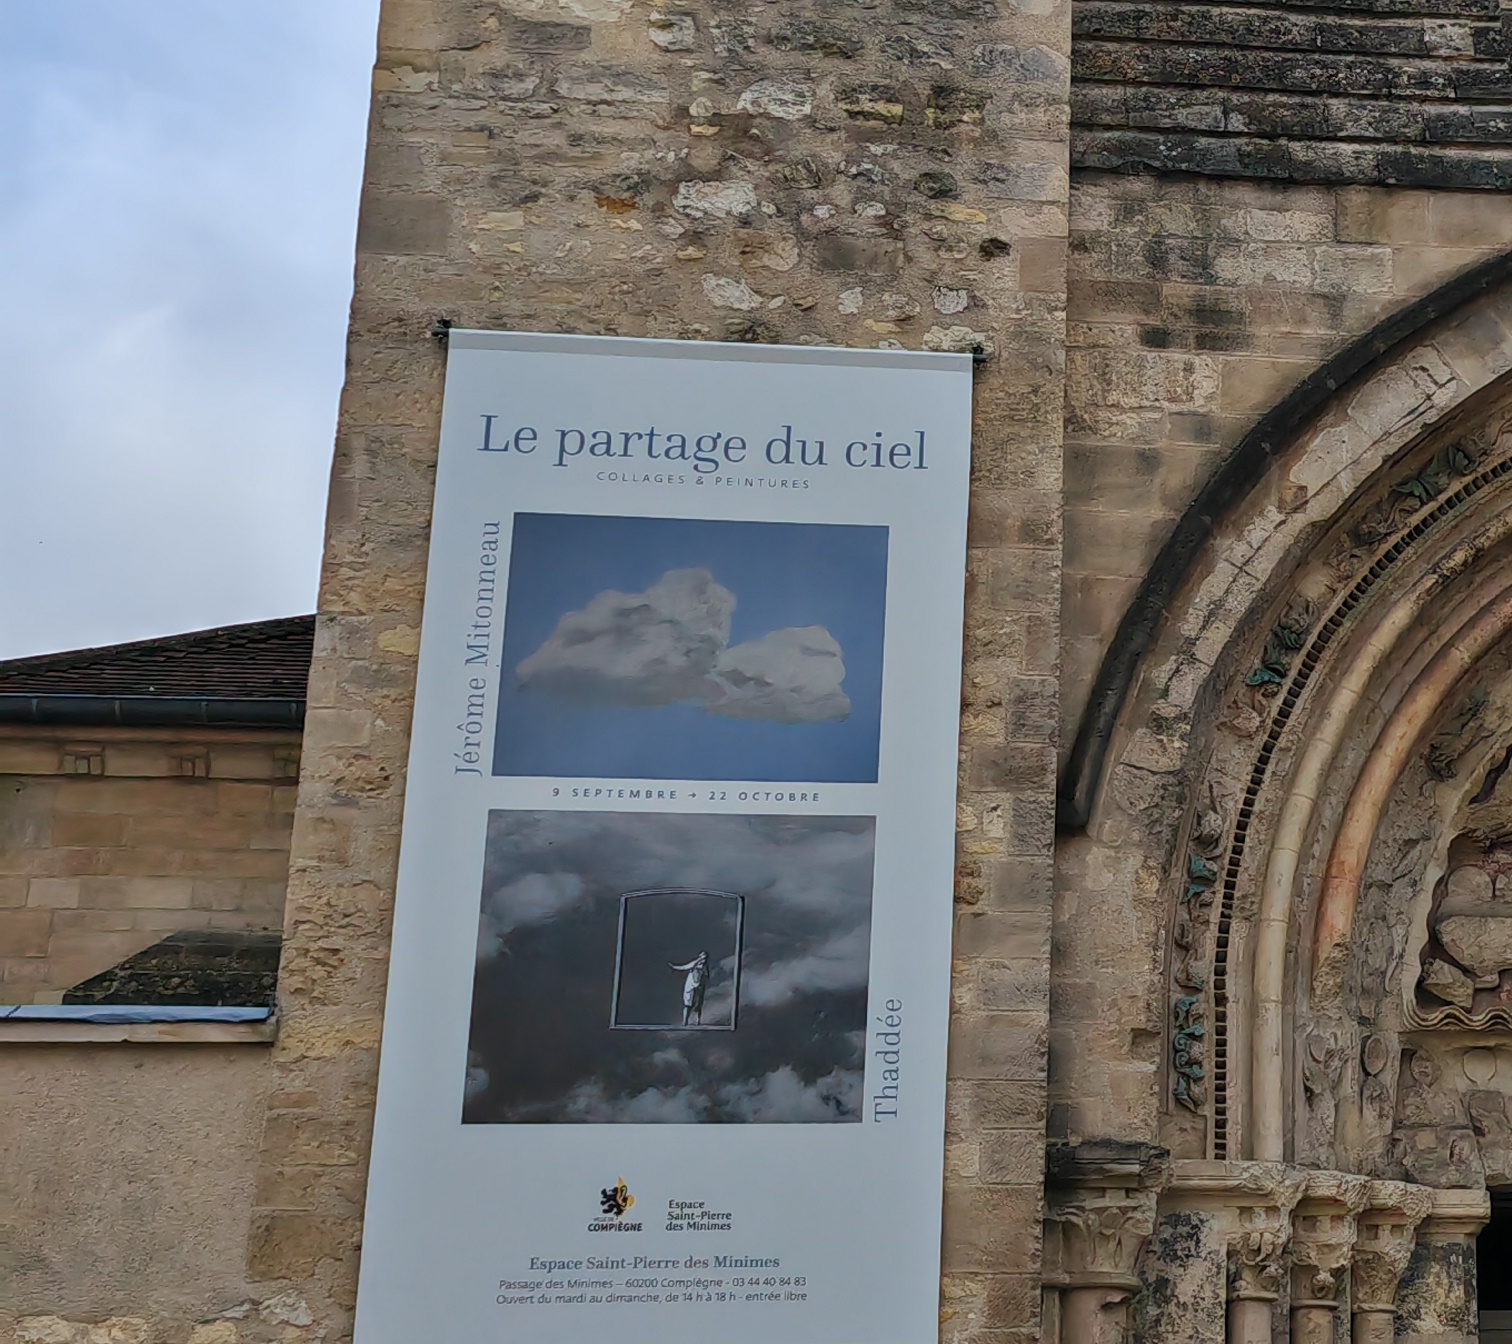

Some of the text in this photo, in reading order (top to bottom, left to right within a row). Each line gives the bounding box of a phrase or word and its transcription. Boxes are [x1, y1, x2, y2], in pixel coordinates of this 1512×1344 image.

[477, 414, 929, 474] Le partage du ciel
[596, 471, 810, 489] COLLAGES & PEINTURES
[453, 521, 501, 777] Jérôme Mitonneau
[552, 787, 821, 802] 9 SEPTEMBRE 22 OCTOBRE
[873, 998, 903, 1123] Thaddée
[668, 1199, 705, 1211] Espace
[667, 1210, 733, 1221] Saint-Pierre
[587, 1220, 643, 1232] COMPIÈGNE
[665, 1221, 732, 1231] des Minimes
[529, 1255, 780, 1274] Espace Saint-Pierre des Minimes
[499, 1279, 543, 1292] Passage
[545, 1278, 565, 1289] des
[567, 1278, 613, 1289] Minimes
[625, 1278, 658, 1288] 60200
[661, 1277, 723, 1290] Compiègne
[732, 1277, 745, 1287] 03
[747, 1277, 760, 1287] 44
[762, 1277, 776, 1287] 40
[778, 1277, 791, 1287] 84
[793, 1276, 807, 1287] 83
[496, 1294, 535, 1304] Ouvert
[537, 1293, 552, 1304] du
[555, 1293, 587, 1303] mardi
[589, 1294, 603, 1303] au
[605, 1292, 661, 1304] dimanche,
[665, 1292, 679, 1302] de
[683, 1292, 693, 1302] 14
[696, 1292, 703, 1302] h
[705, 1292, 712, 1302] à
[715, 1291, 726, 1302] 18
[729, 1291, 736, 1301] h
[745, 1291, 781, 1301] entrée
[784, 1290, 808, 1301] libre
